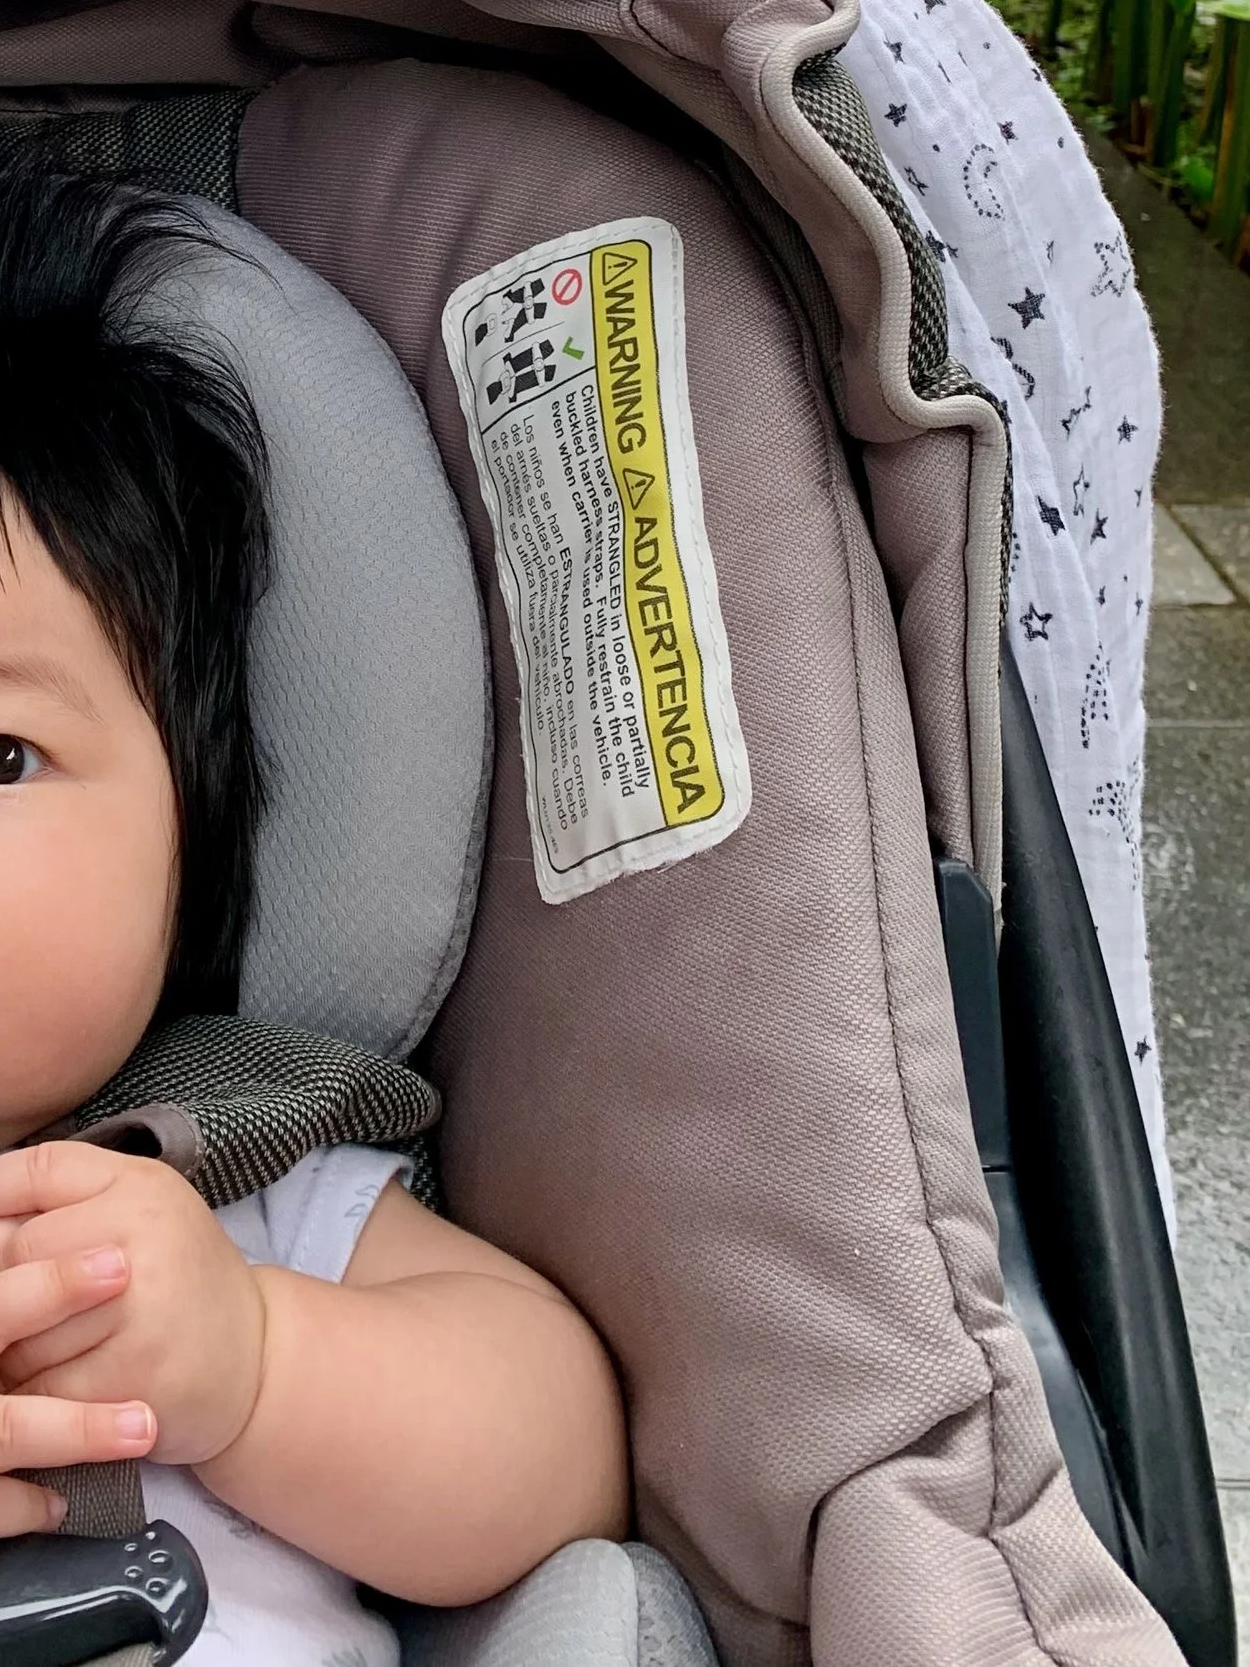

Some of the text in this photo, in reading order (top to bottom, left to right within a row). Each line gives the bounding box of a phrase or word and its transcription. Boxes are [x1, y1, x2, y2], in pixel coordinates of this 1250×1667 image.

[490, 438, 501, 453] el
[499, 430, 509, 451] de
[509, 422, 524, 448] del
[515, 449, 532, 494] arnés
[509, 521, 520, 542] se
[527, 496, 551, 552] sueltas
[602, 280, 706, 813] WARNING ADVERTENCIA
[516, 544, 536, 589] utiliza
[522, 524, 546, 640] completamente
[547, 554, 557, 566] o
[527, 590, 538, 632] fuera
[551, 400, 611, 786] even when carrier is used outside the vehicle.
[566, 391, 635, 797] buckled harness straps. Fully restrain the child
[581, 385, 650, 788] Children have STRANGLED in loose or partially
[522, 413, 588, 818] Los niños se han ESTRANGULADO en las correas
[548, 568, 562, 669] parcialmente
[531, 635, 542, 659] del
[545, 704, 558, 764] incluso
[551, 767, 568, 831] cuando
[563, 776, 578, 825] Debe
